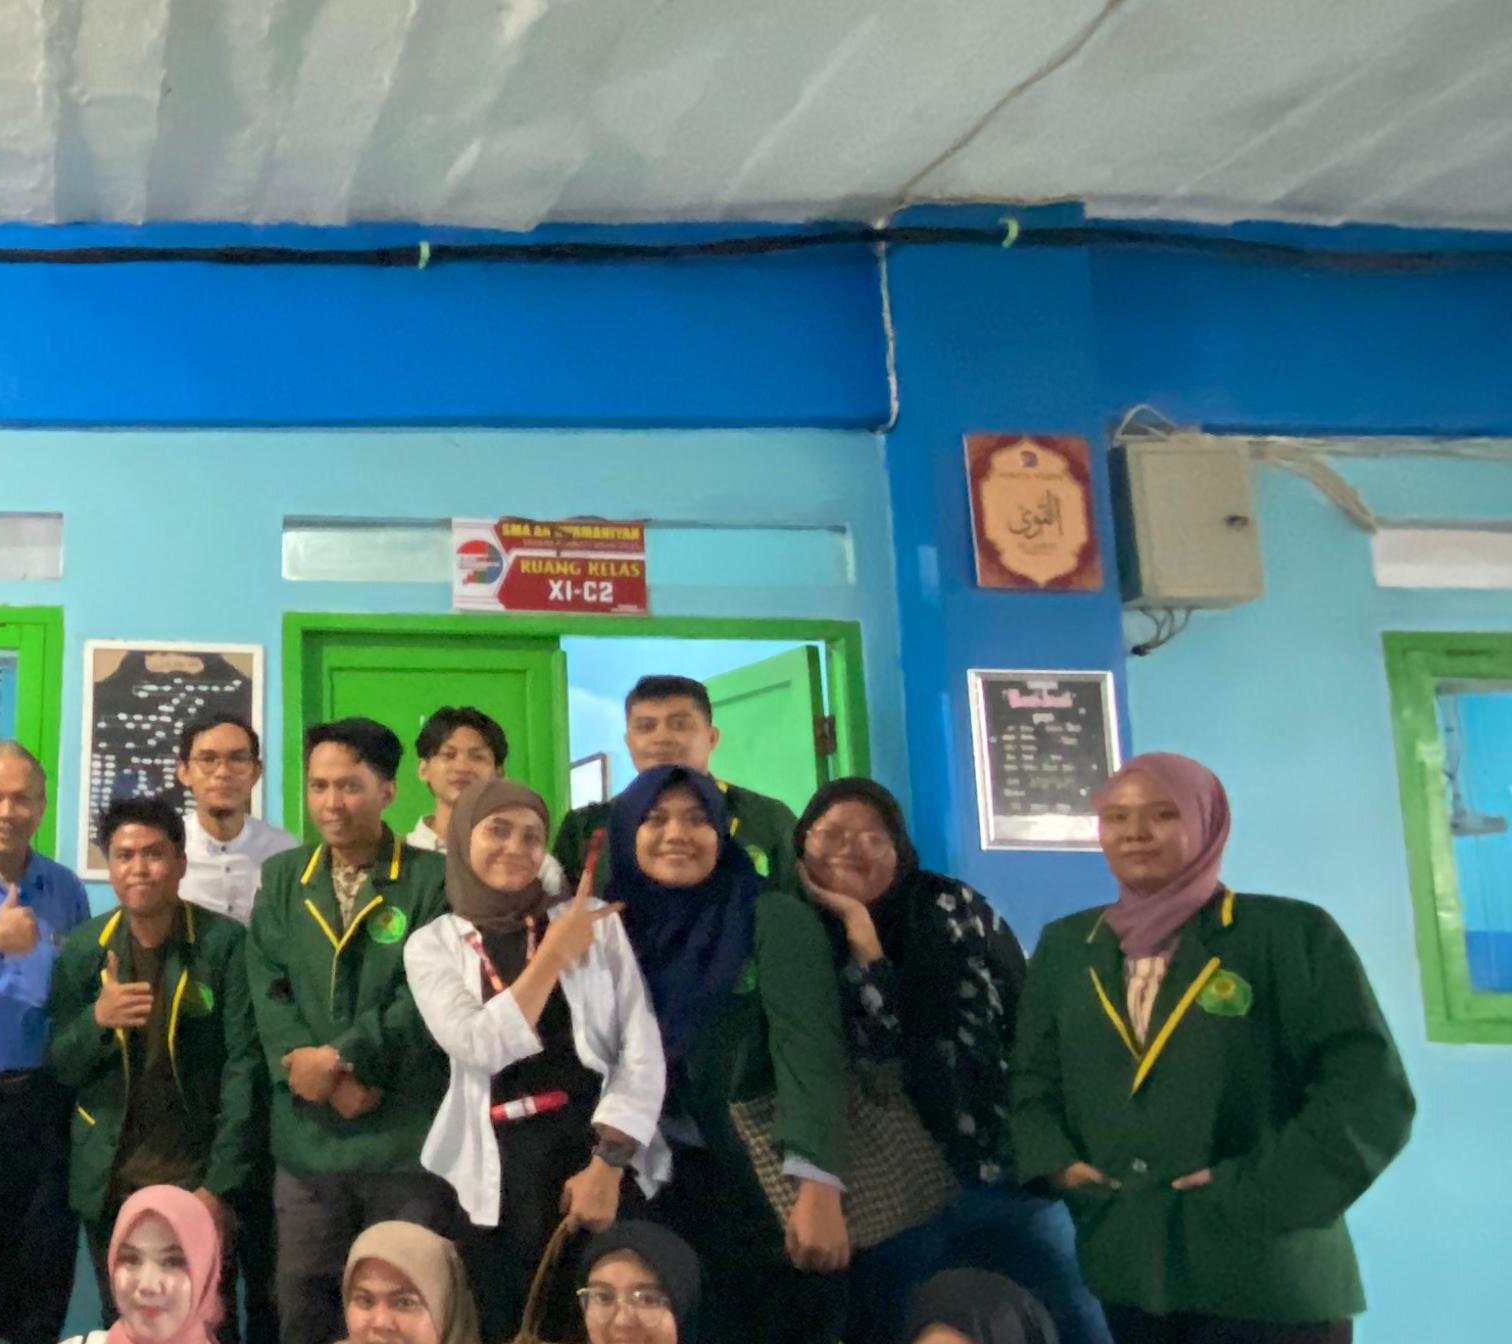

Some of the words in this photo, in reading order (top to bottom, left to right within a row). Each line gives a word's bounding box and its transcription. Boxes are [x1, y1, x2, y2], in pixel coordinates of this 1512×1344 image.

[520, 559, 582, 576] RUANG
[588, 561, 640, 577] KELAS
[548, 579, 614, 602] XI-C2
